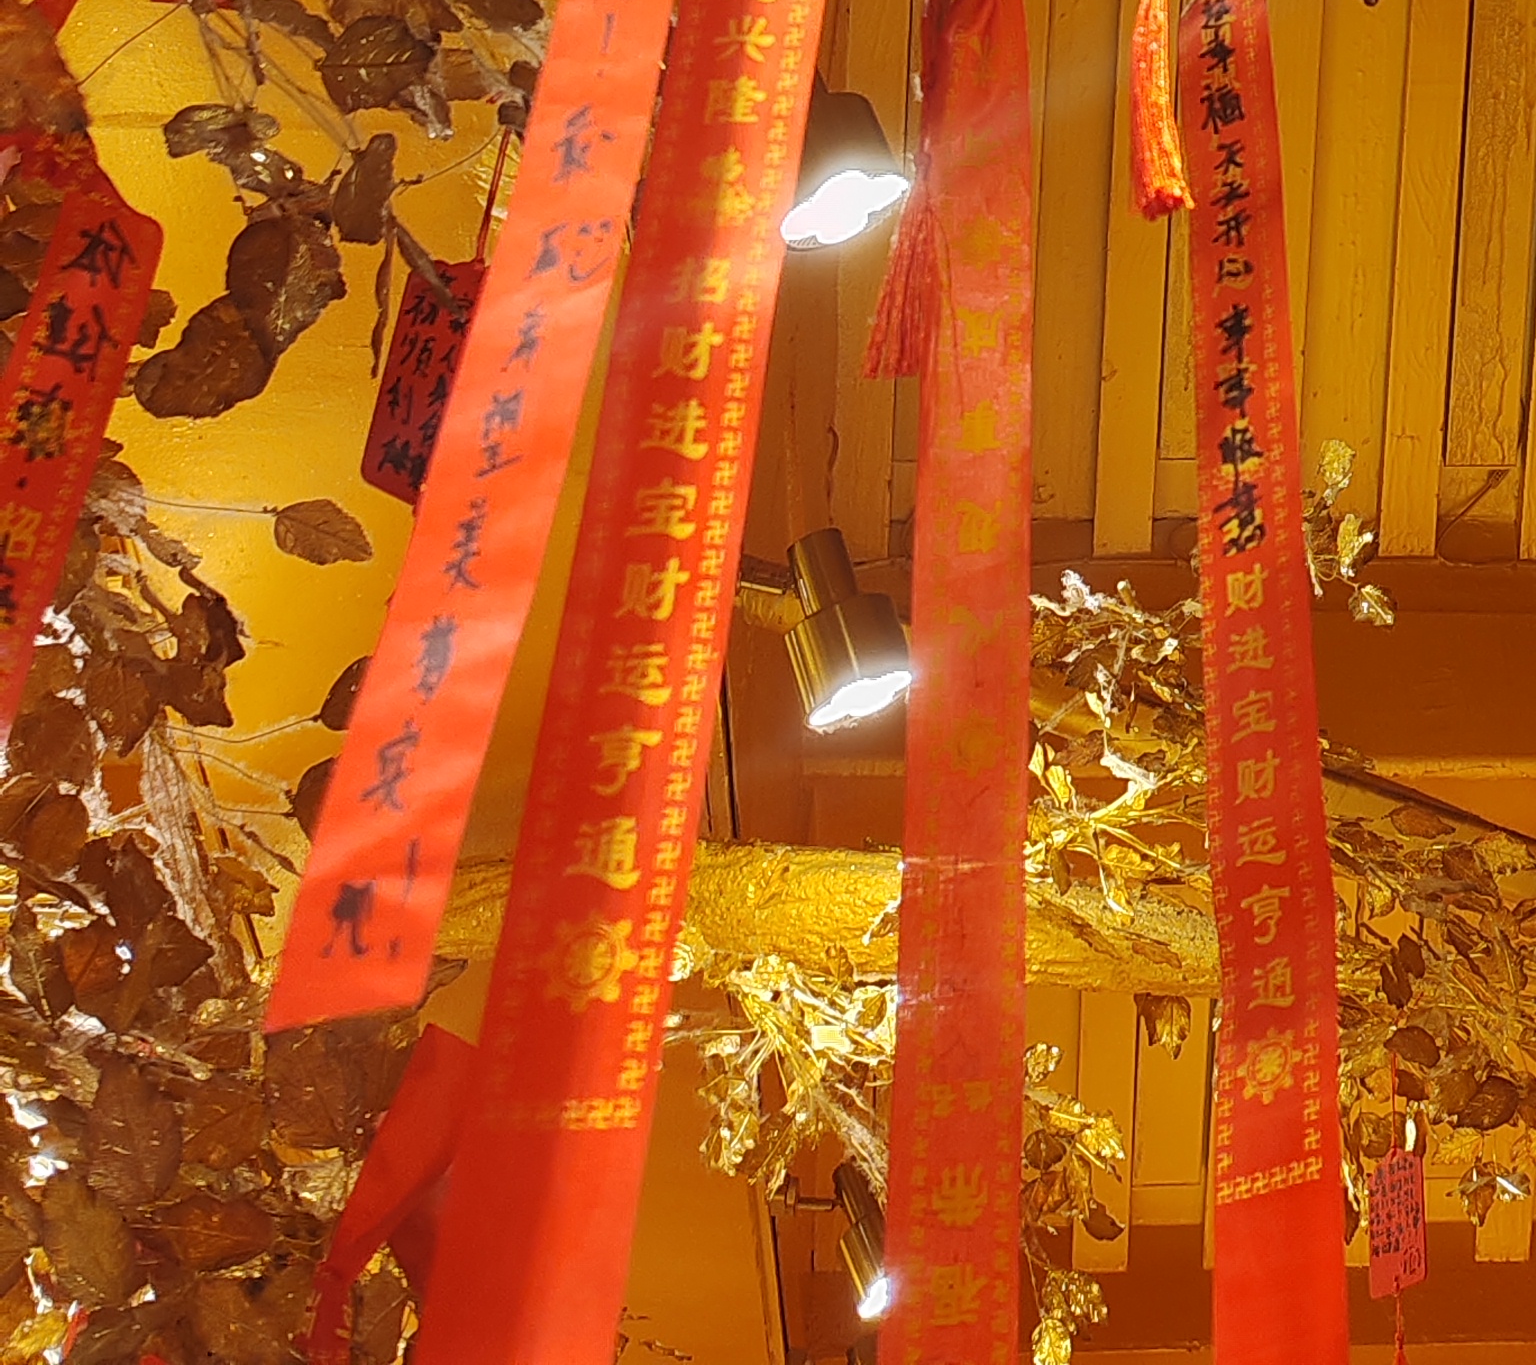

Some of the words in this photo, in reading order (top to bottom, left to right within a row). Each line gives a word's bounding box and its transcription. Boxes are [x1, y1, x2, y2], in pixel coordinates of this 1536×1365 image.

[562, 255, 732, 894] 招财进宝财运亨通
